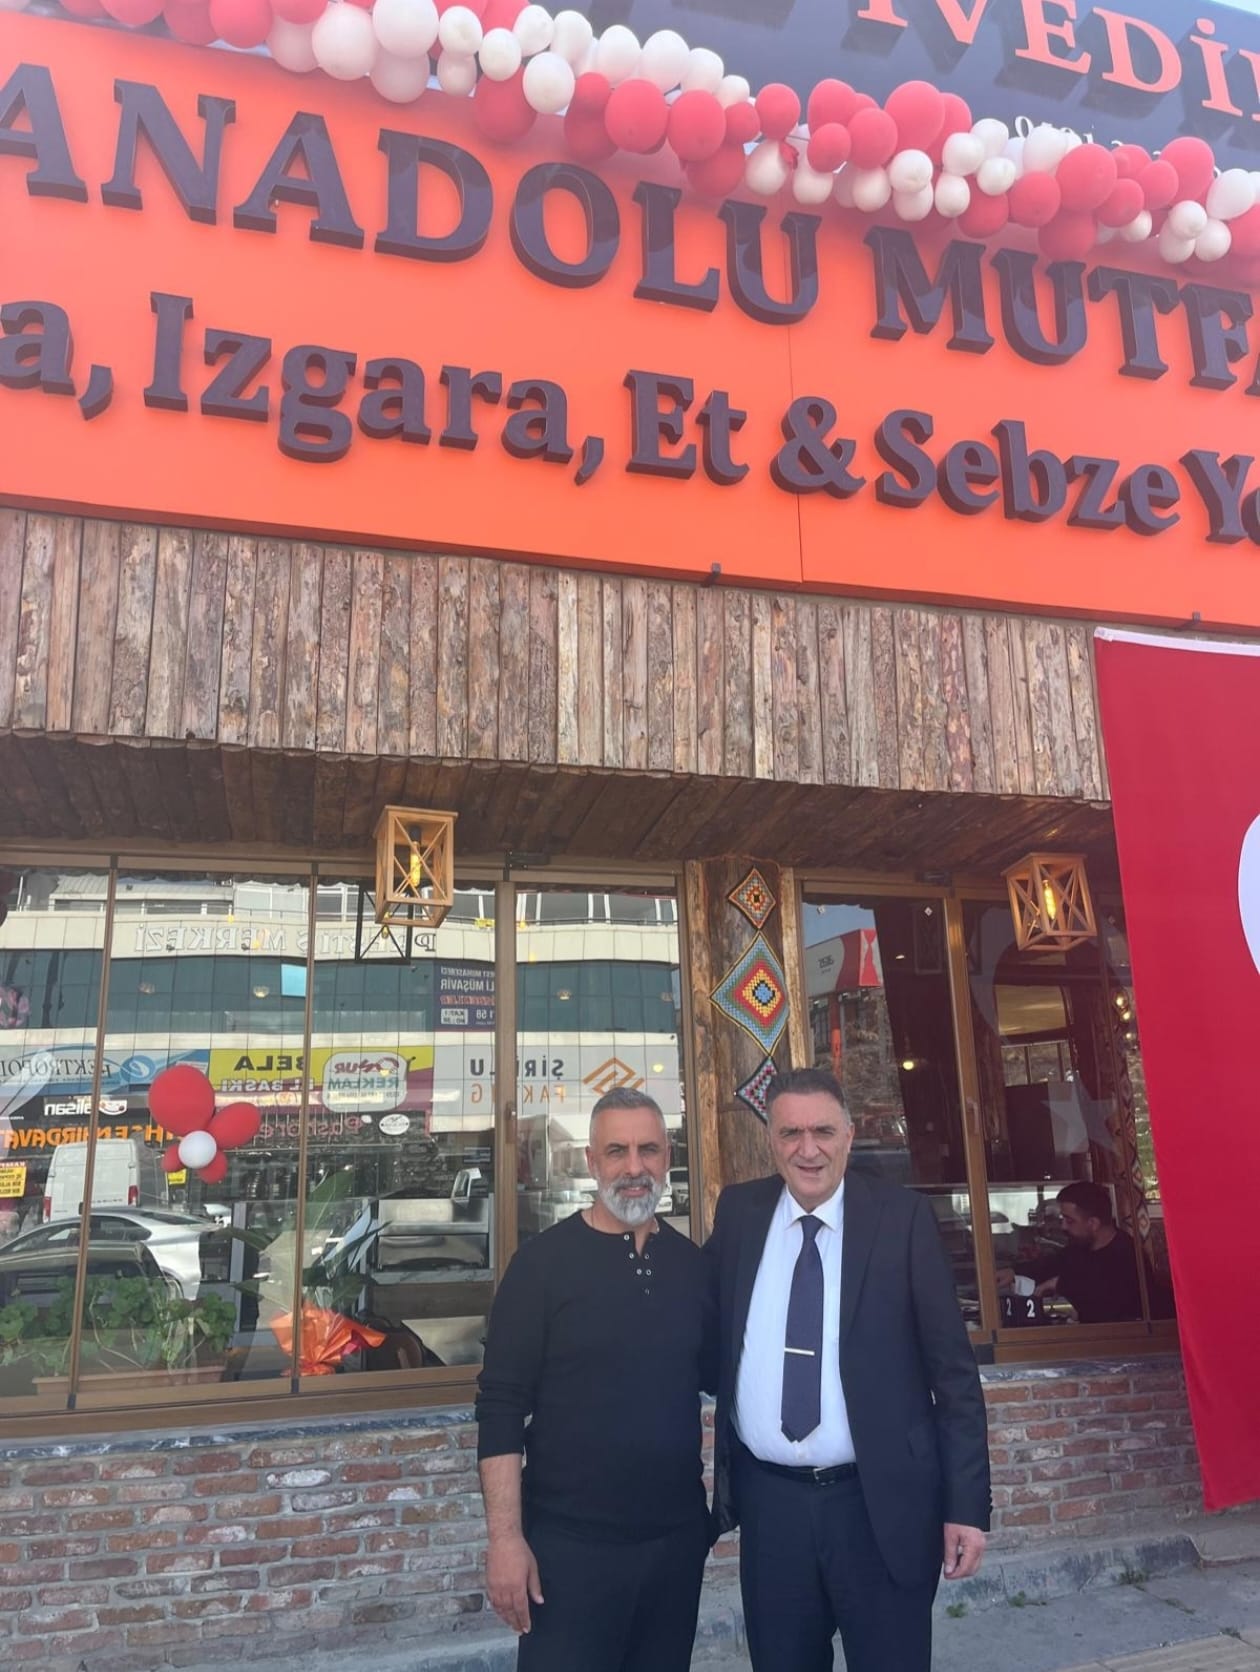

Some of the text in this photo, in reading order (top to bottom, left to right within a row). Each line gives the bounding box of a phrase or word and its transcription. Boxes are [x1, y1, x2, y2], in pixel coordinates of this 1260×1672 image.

[0, 62, 1260, 397] ANADOLU MUTF
[143, 291, 605, 487] Izgara,
[623, 369, 750, 487] Et
[769, 395, 867, 500] &
[1026, 1298, 1036, 1319] 2
